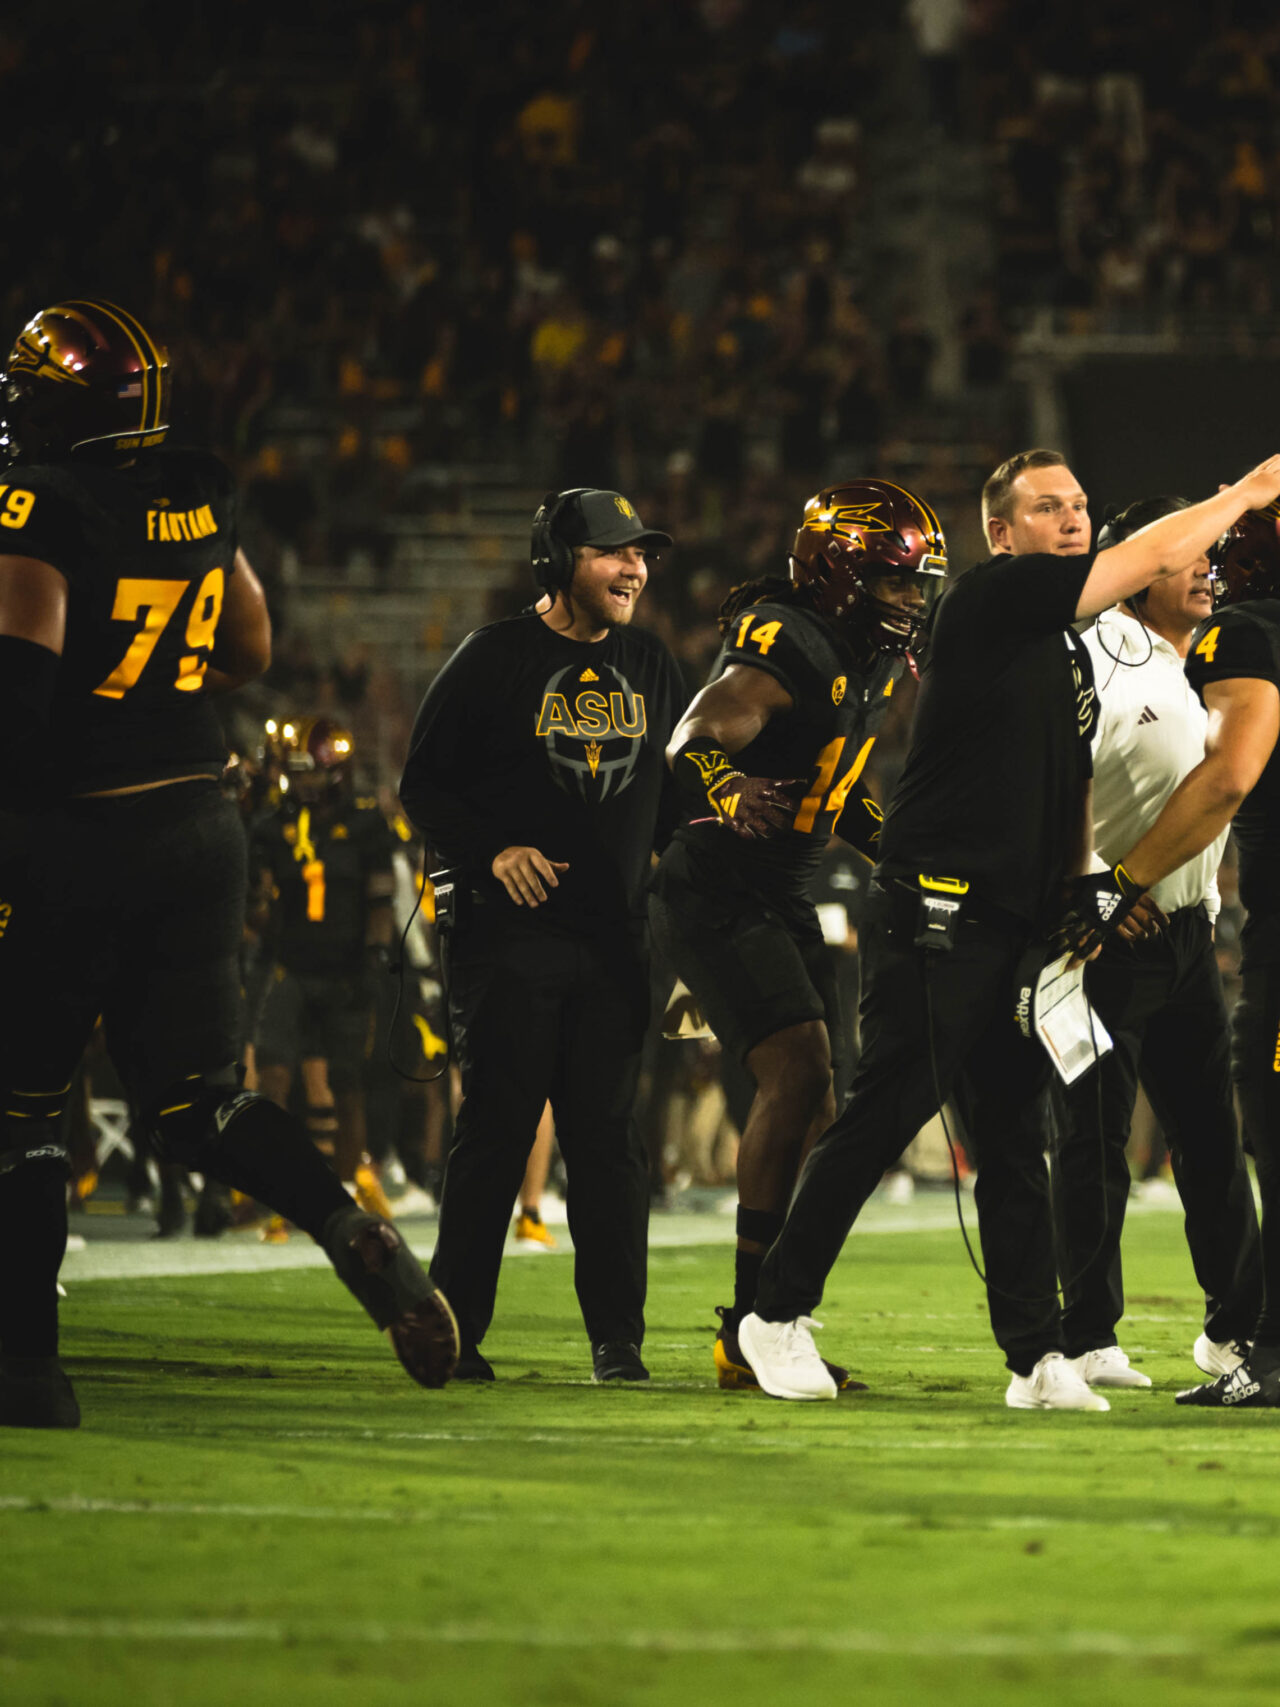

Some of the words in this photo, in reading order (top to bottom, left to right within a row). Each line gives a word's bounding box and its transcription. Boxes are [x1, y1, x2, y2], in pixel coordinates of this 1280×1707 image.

[92, 566, 225, 700] 79
[736, 614, 783, 655] 14
[1195, 626, 1221, 663] 4
[535, 690, 648, 738] ASU
[1222, 1382, 1261, 1405] adidas
